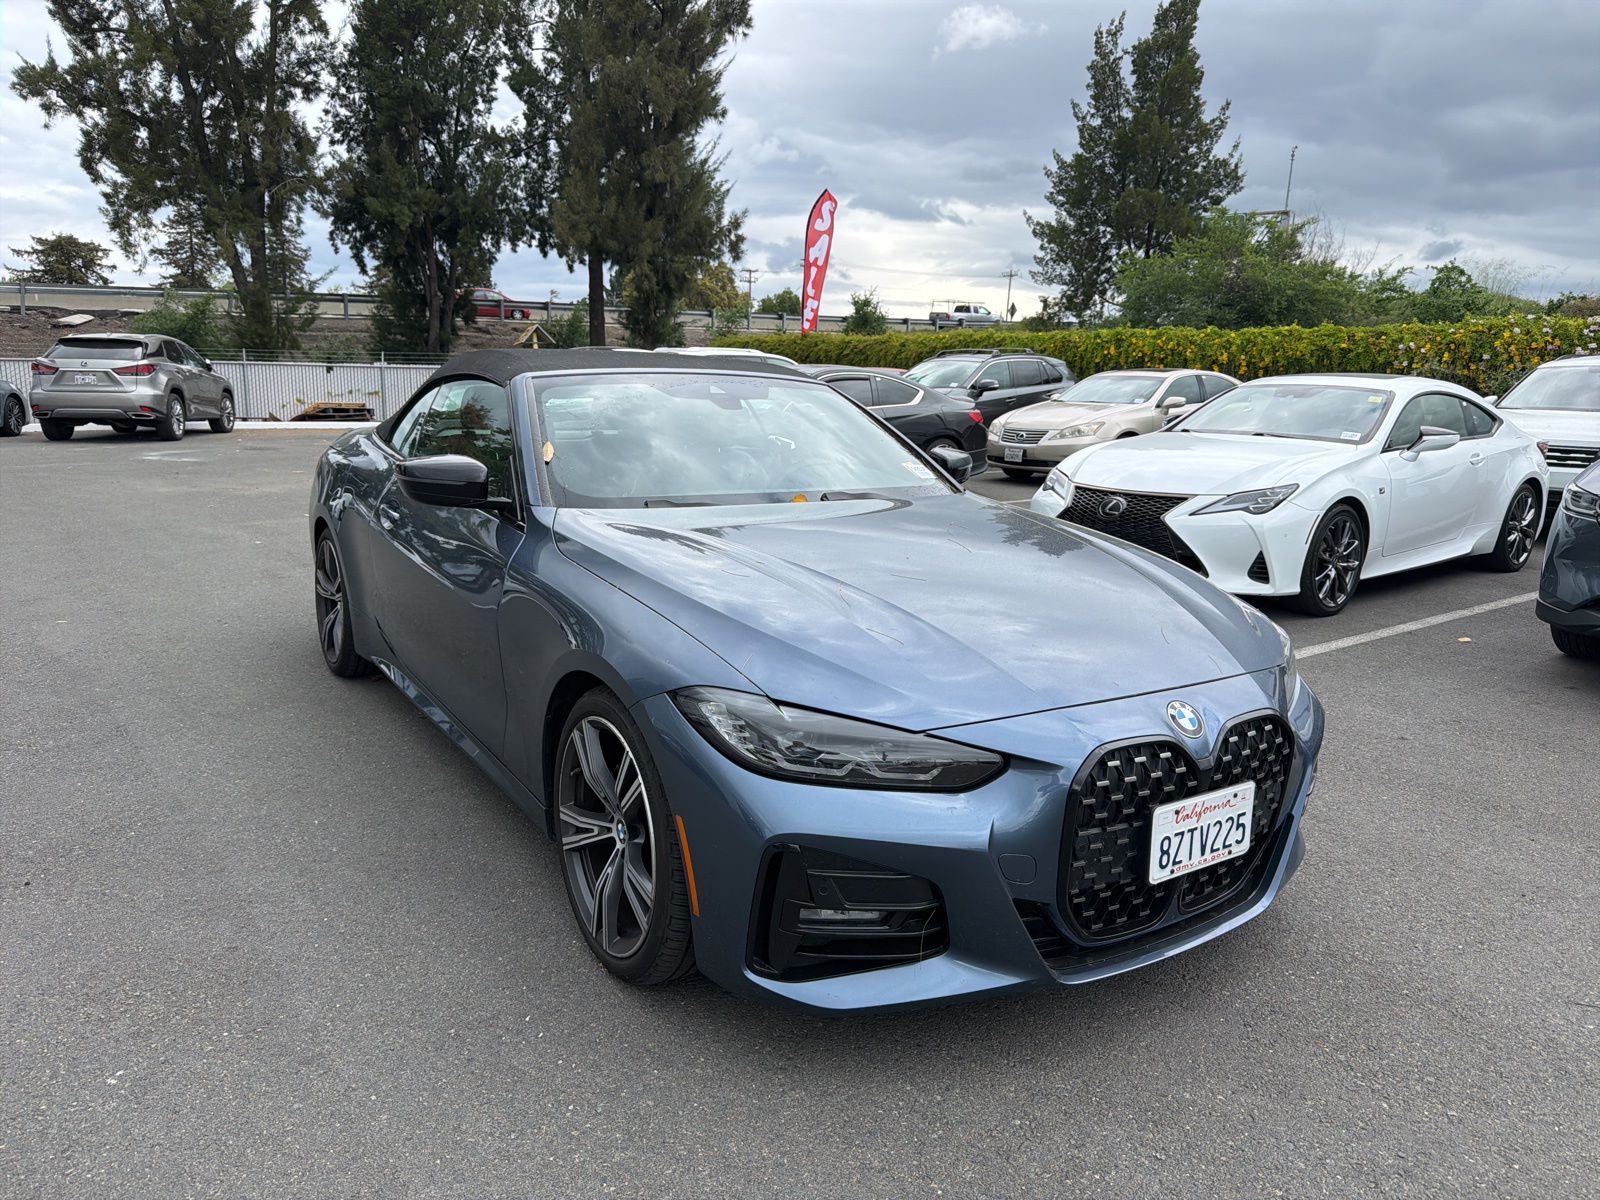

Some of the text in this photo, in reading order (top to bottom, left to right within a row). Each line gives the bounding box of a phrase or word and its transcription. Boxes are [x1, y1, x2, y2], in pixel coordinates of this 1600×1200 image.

[1175, 799, 1237, 824] California
[1158, 811, 1247, 870] 8ZTV225
[1175, 851, 1227, 872] dmv.ca.gov
